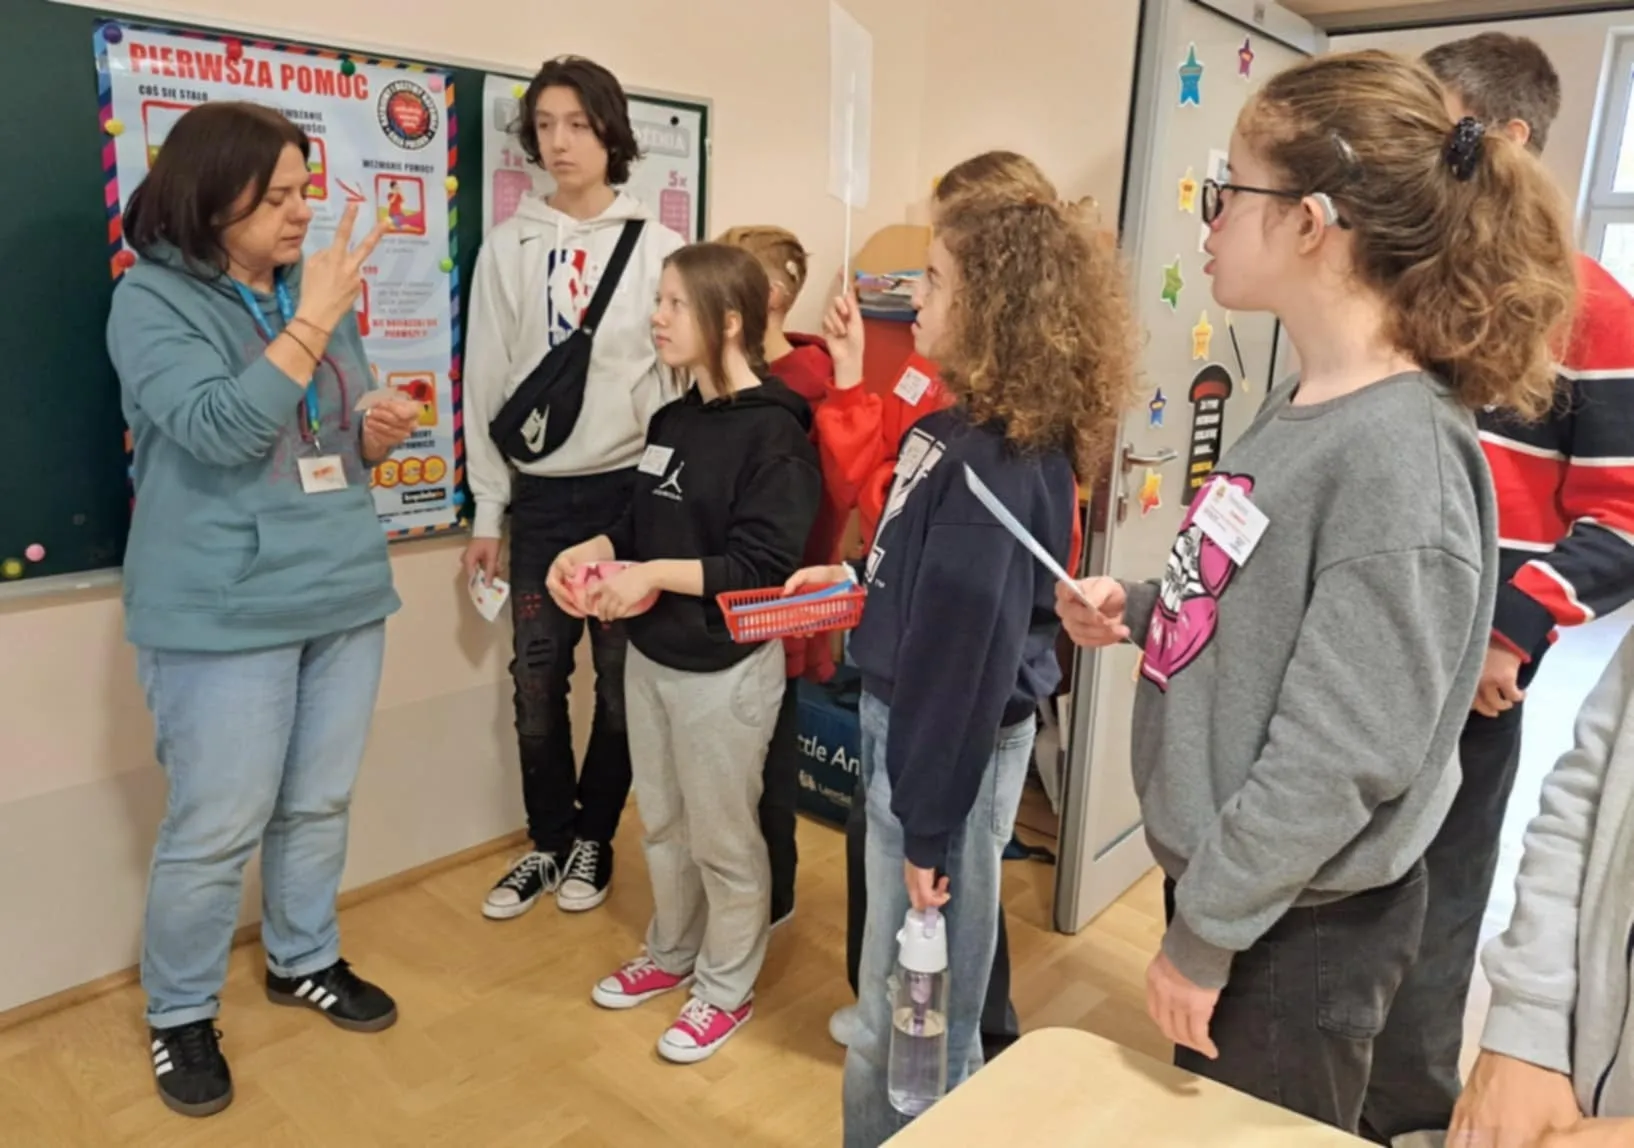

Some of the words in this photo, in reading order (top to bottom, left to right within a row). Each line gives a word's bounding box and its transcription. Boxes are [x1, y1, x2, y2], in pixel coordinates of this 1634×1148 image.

[129, 42, 273, 89] PIERWSZA
[280, 63, 369, 101] POMOC
[798, 734, 828, 762] tle
[830, 745, 860, 776] An
